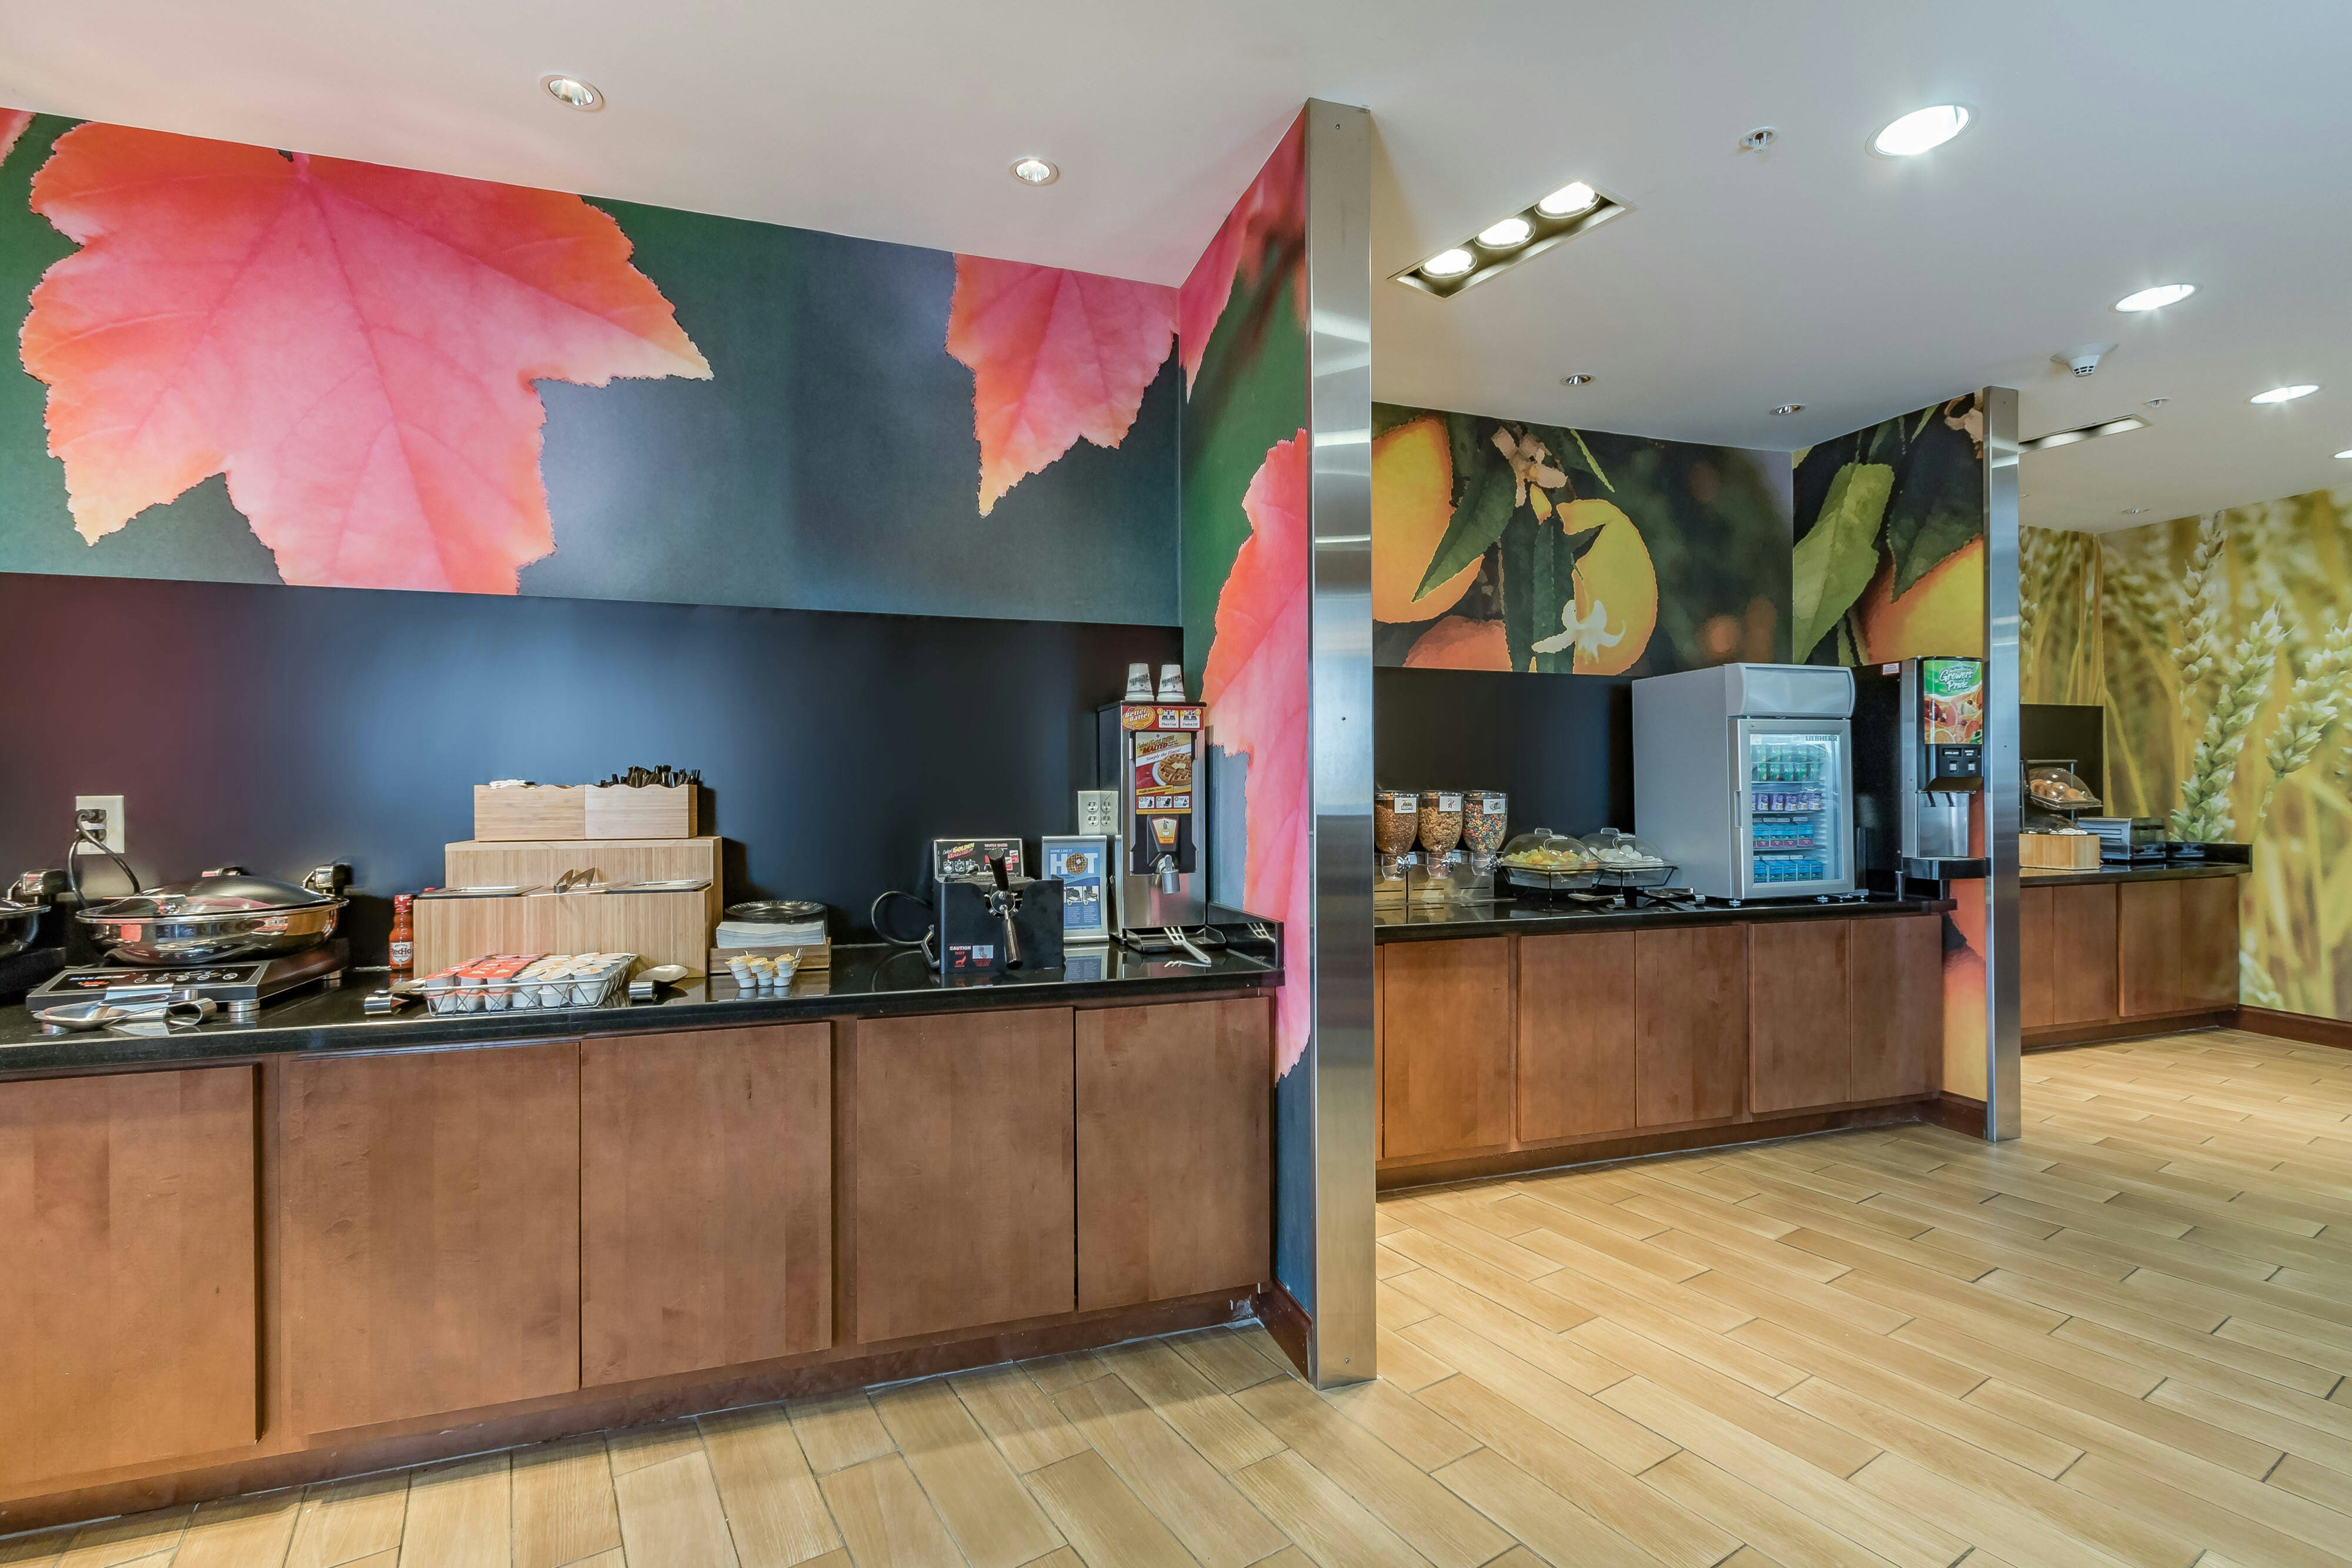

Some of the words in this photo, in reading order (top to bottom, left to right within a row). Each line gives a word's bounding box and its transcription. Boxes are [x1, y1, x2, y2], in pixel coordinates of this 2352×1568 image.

[1946, 679, 1969, 691] Pride
[1125, 707, 1147, 718] Better
[1129, 712, 1151, 723] Batter
[1142, 742, 1168, 755] MALTED
[953, 842, 975, 852] GOLDEN
